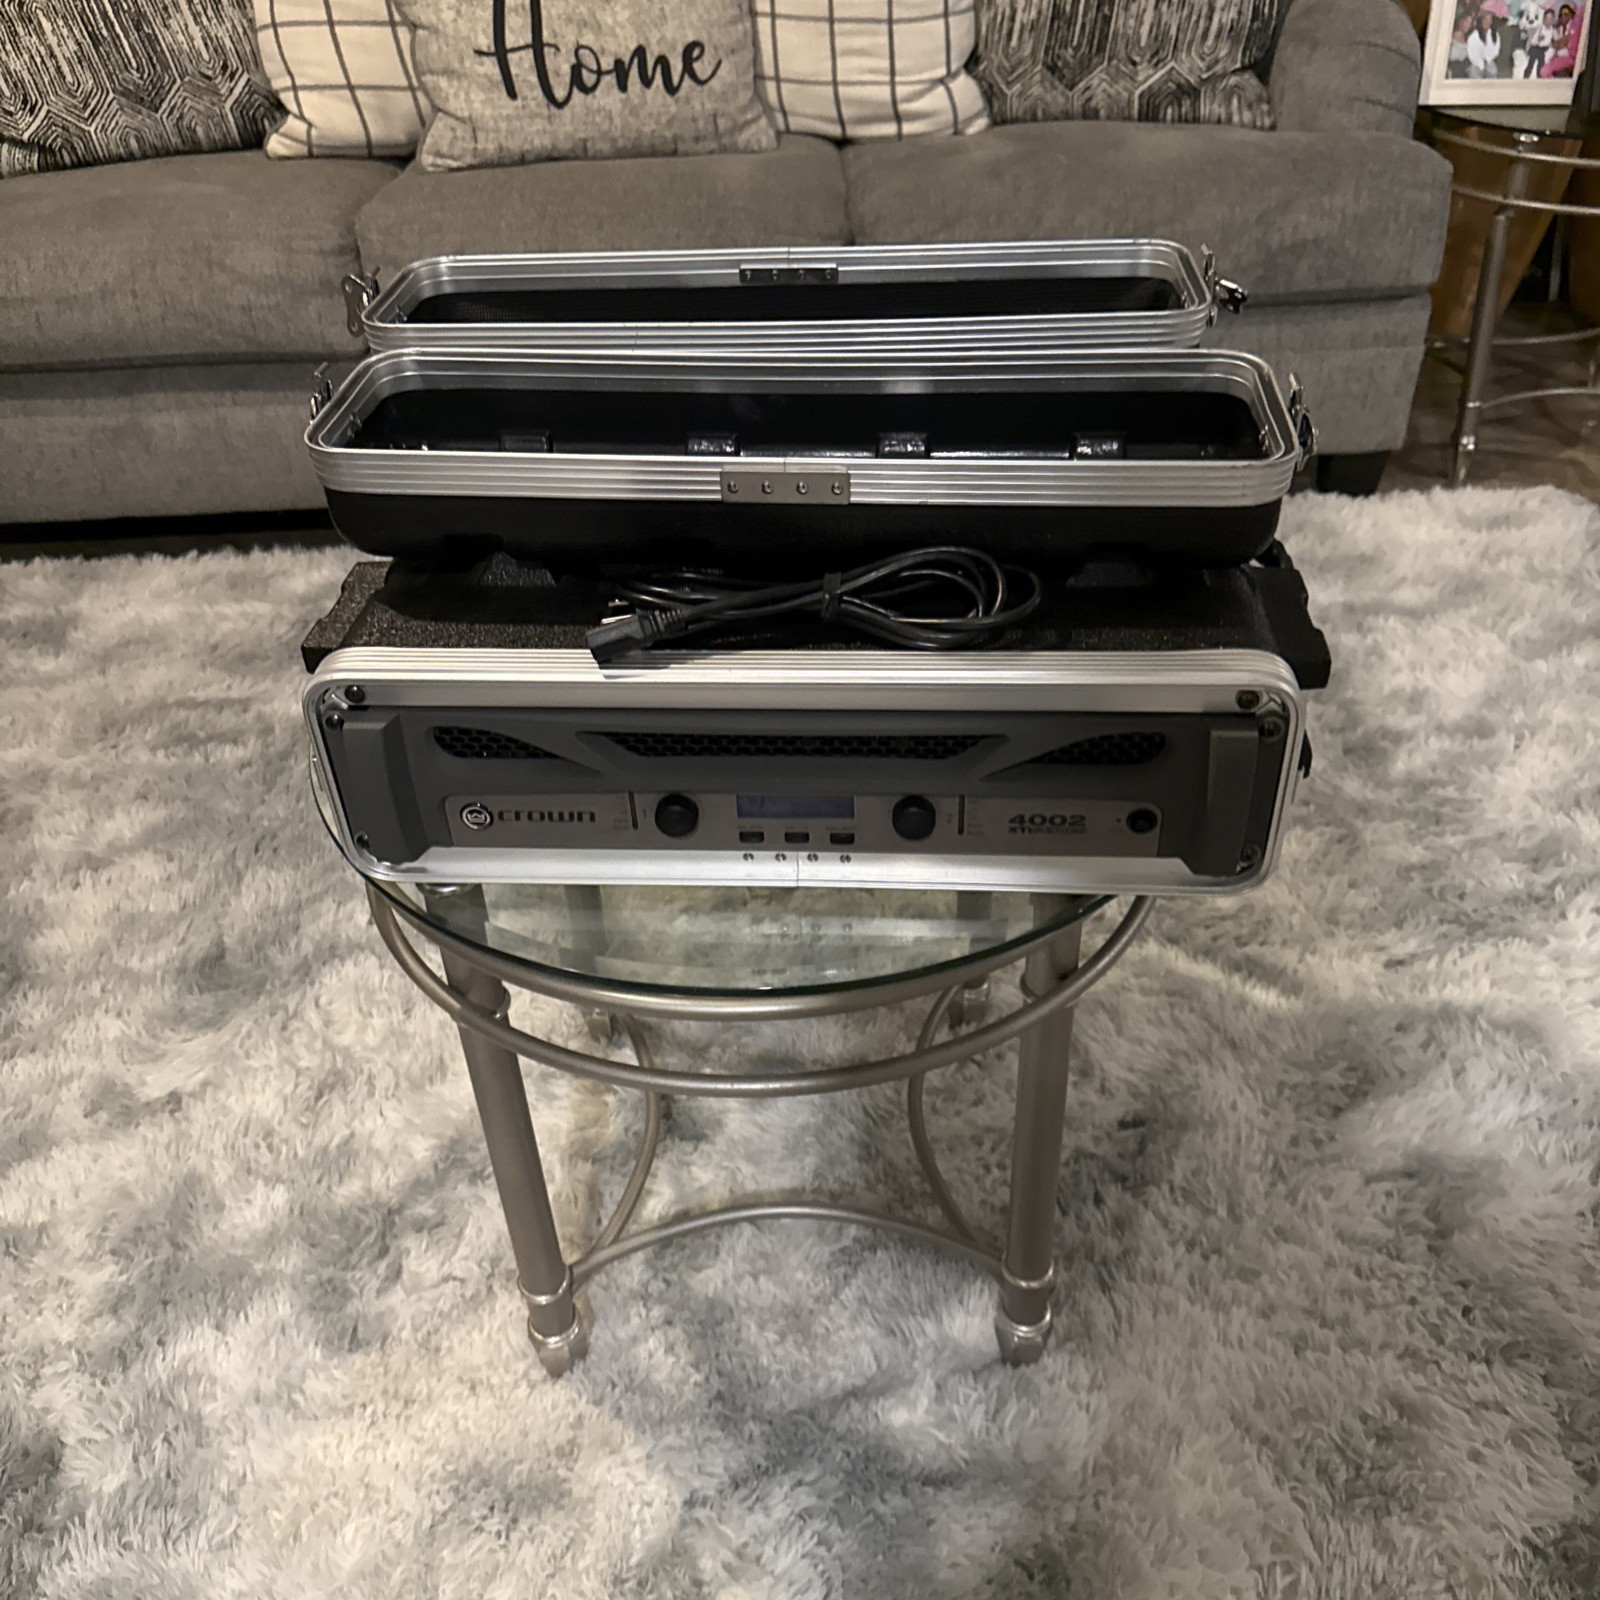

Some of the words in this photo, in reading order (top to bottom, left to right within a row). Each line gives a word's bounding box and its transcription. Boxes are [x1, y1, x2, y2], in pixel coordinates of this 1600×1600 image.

[473, 0, 722, 109] Home
[498, 810, 596, 822] crown
[1008, 814, 1087, 827] 4002
